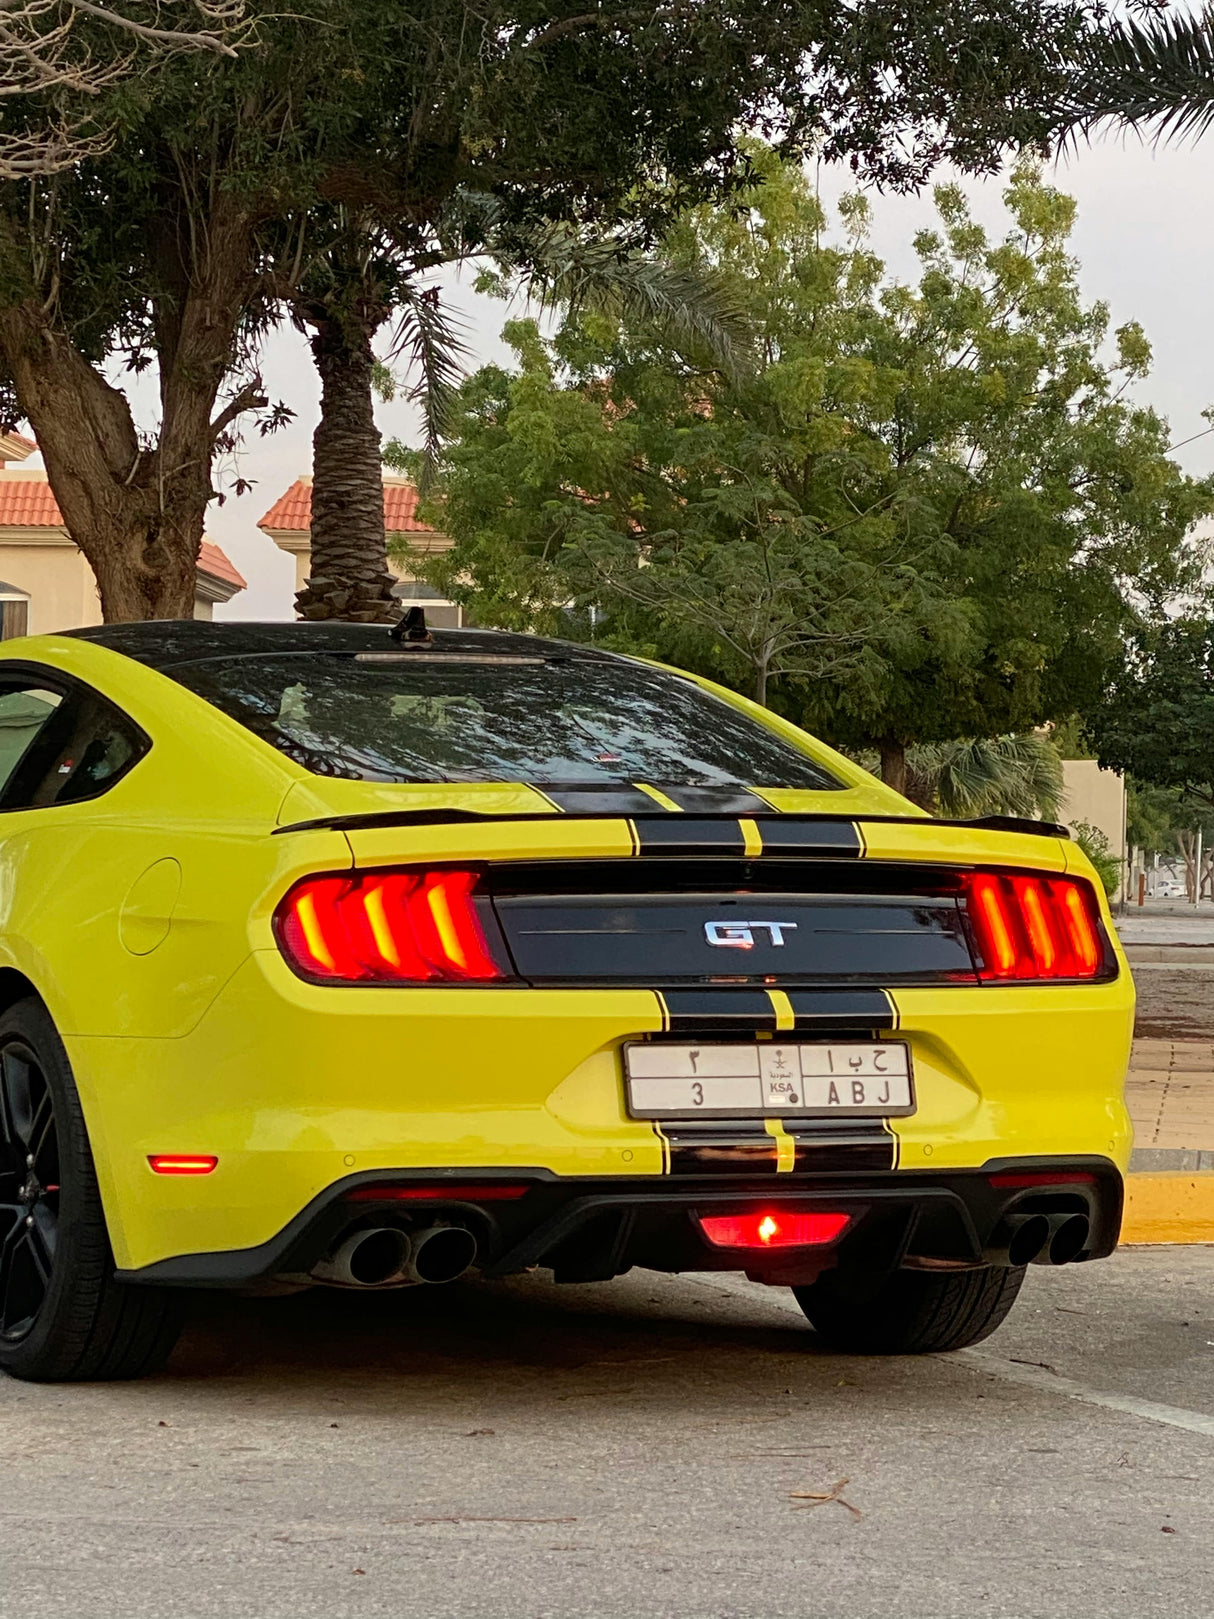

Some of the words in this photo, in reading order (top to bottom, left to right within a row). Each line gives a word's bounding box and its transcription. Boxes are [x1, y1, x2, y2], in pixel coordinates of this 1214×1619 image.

[704, 921, 798, 948] GT
[690, 1082, 704, 1106] 3
[770, 1082, 794, 1093] KSA
